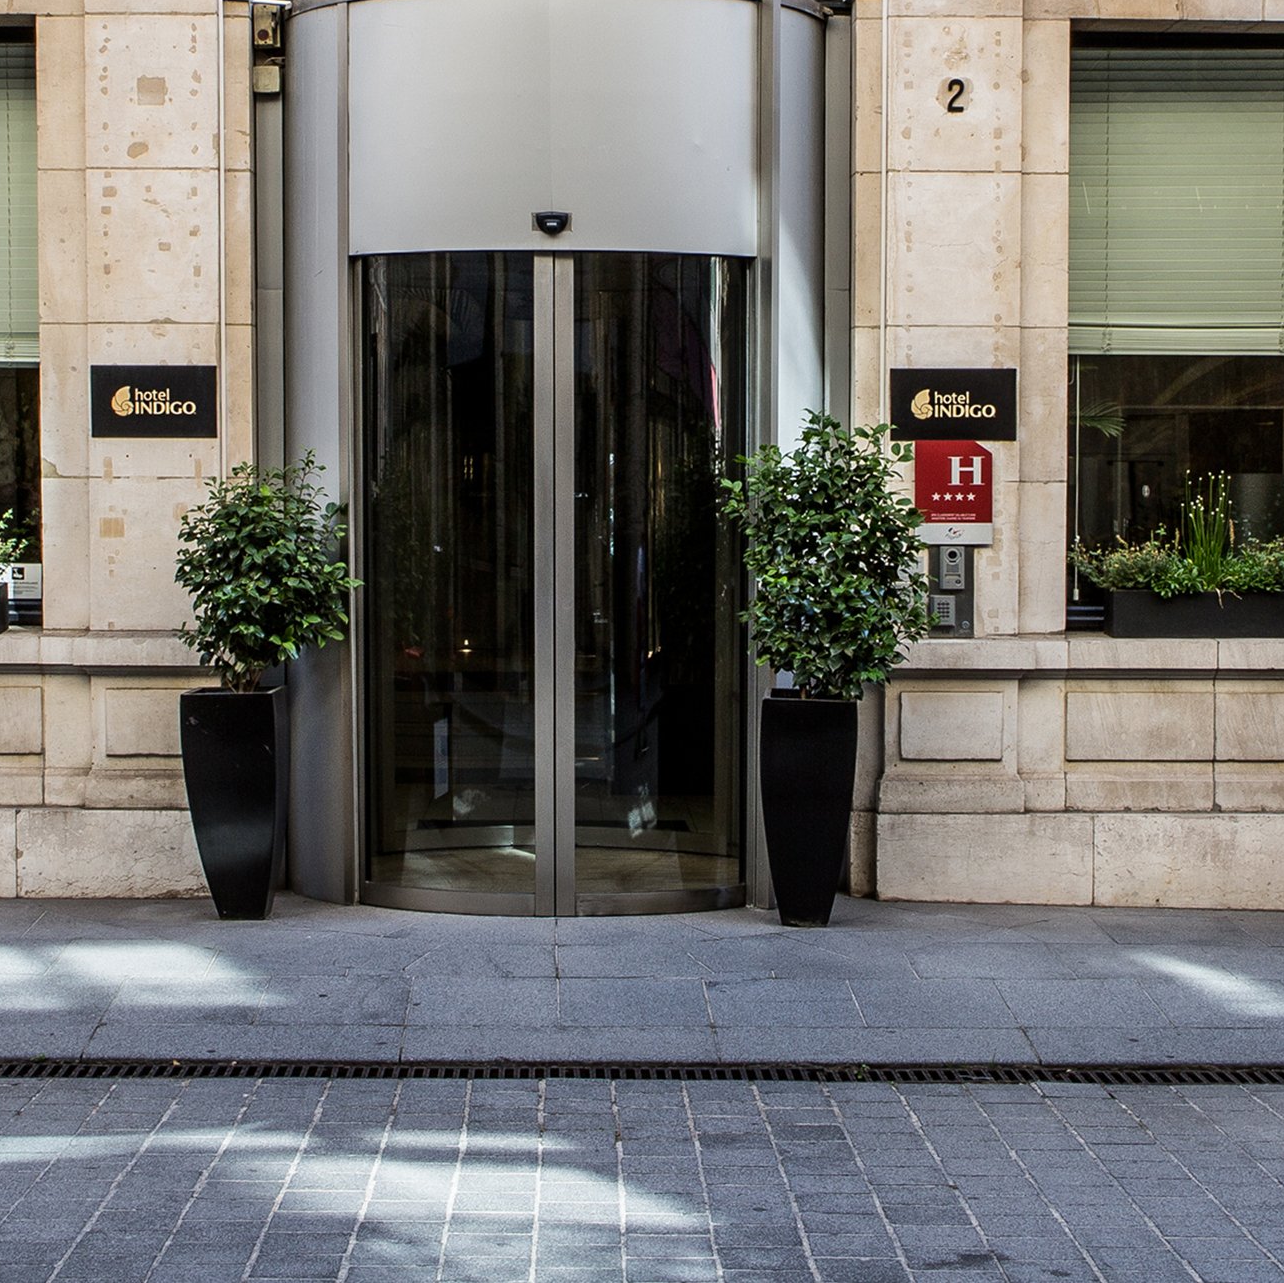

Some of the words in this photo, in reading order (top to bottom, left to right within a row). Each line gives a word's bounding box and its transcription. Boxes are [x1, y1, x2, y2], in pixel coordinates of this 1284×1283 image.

[947, 78, 965, 113] 2
[134, 387, 171, 401] hotel
[934, 391, 970, 405] hotel
[134, 401, 197, 415] INDIGO
[934, 404, 997, 418] INDIGO
[947, 455, 986, 486] H
